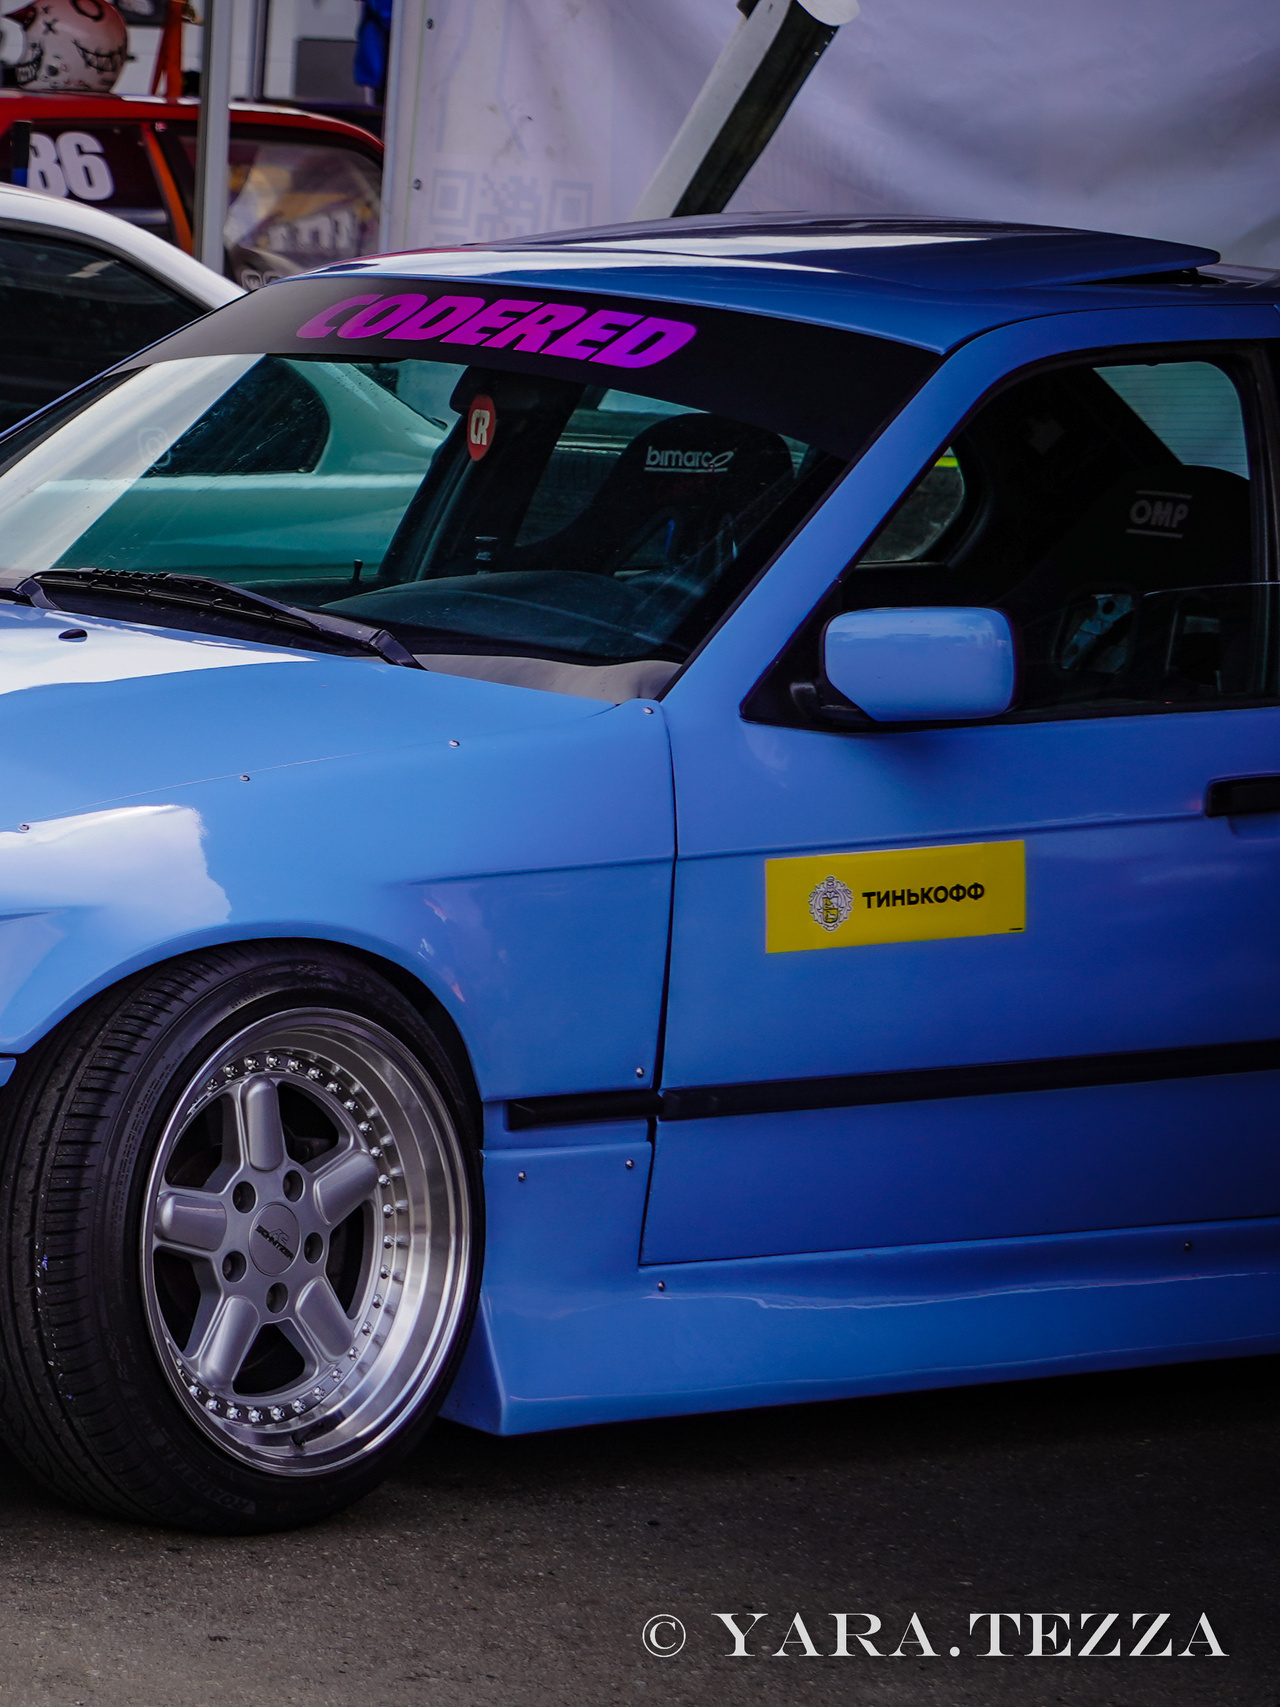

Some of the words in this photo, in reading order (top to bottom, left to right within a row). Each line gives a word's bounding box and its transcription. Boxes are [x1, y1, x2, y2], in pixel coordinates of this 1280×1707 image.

[27, 132, 115, 200] 86
[296, 293, 697, 369] CODERED
[1130, 499, 1189, 528] OMP
[861, 882, 985, 909] ТИНЬКОФФ
